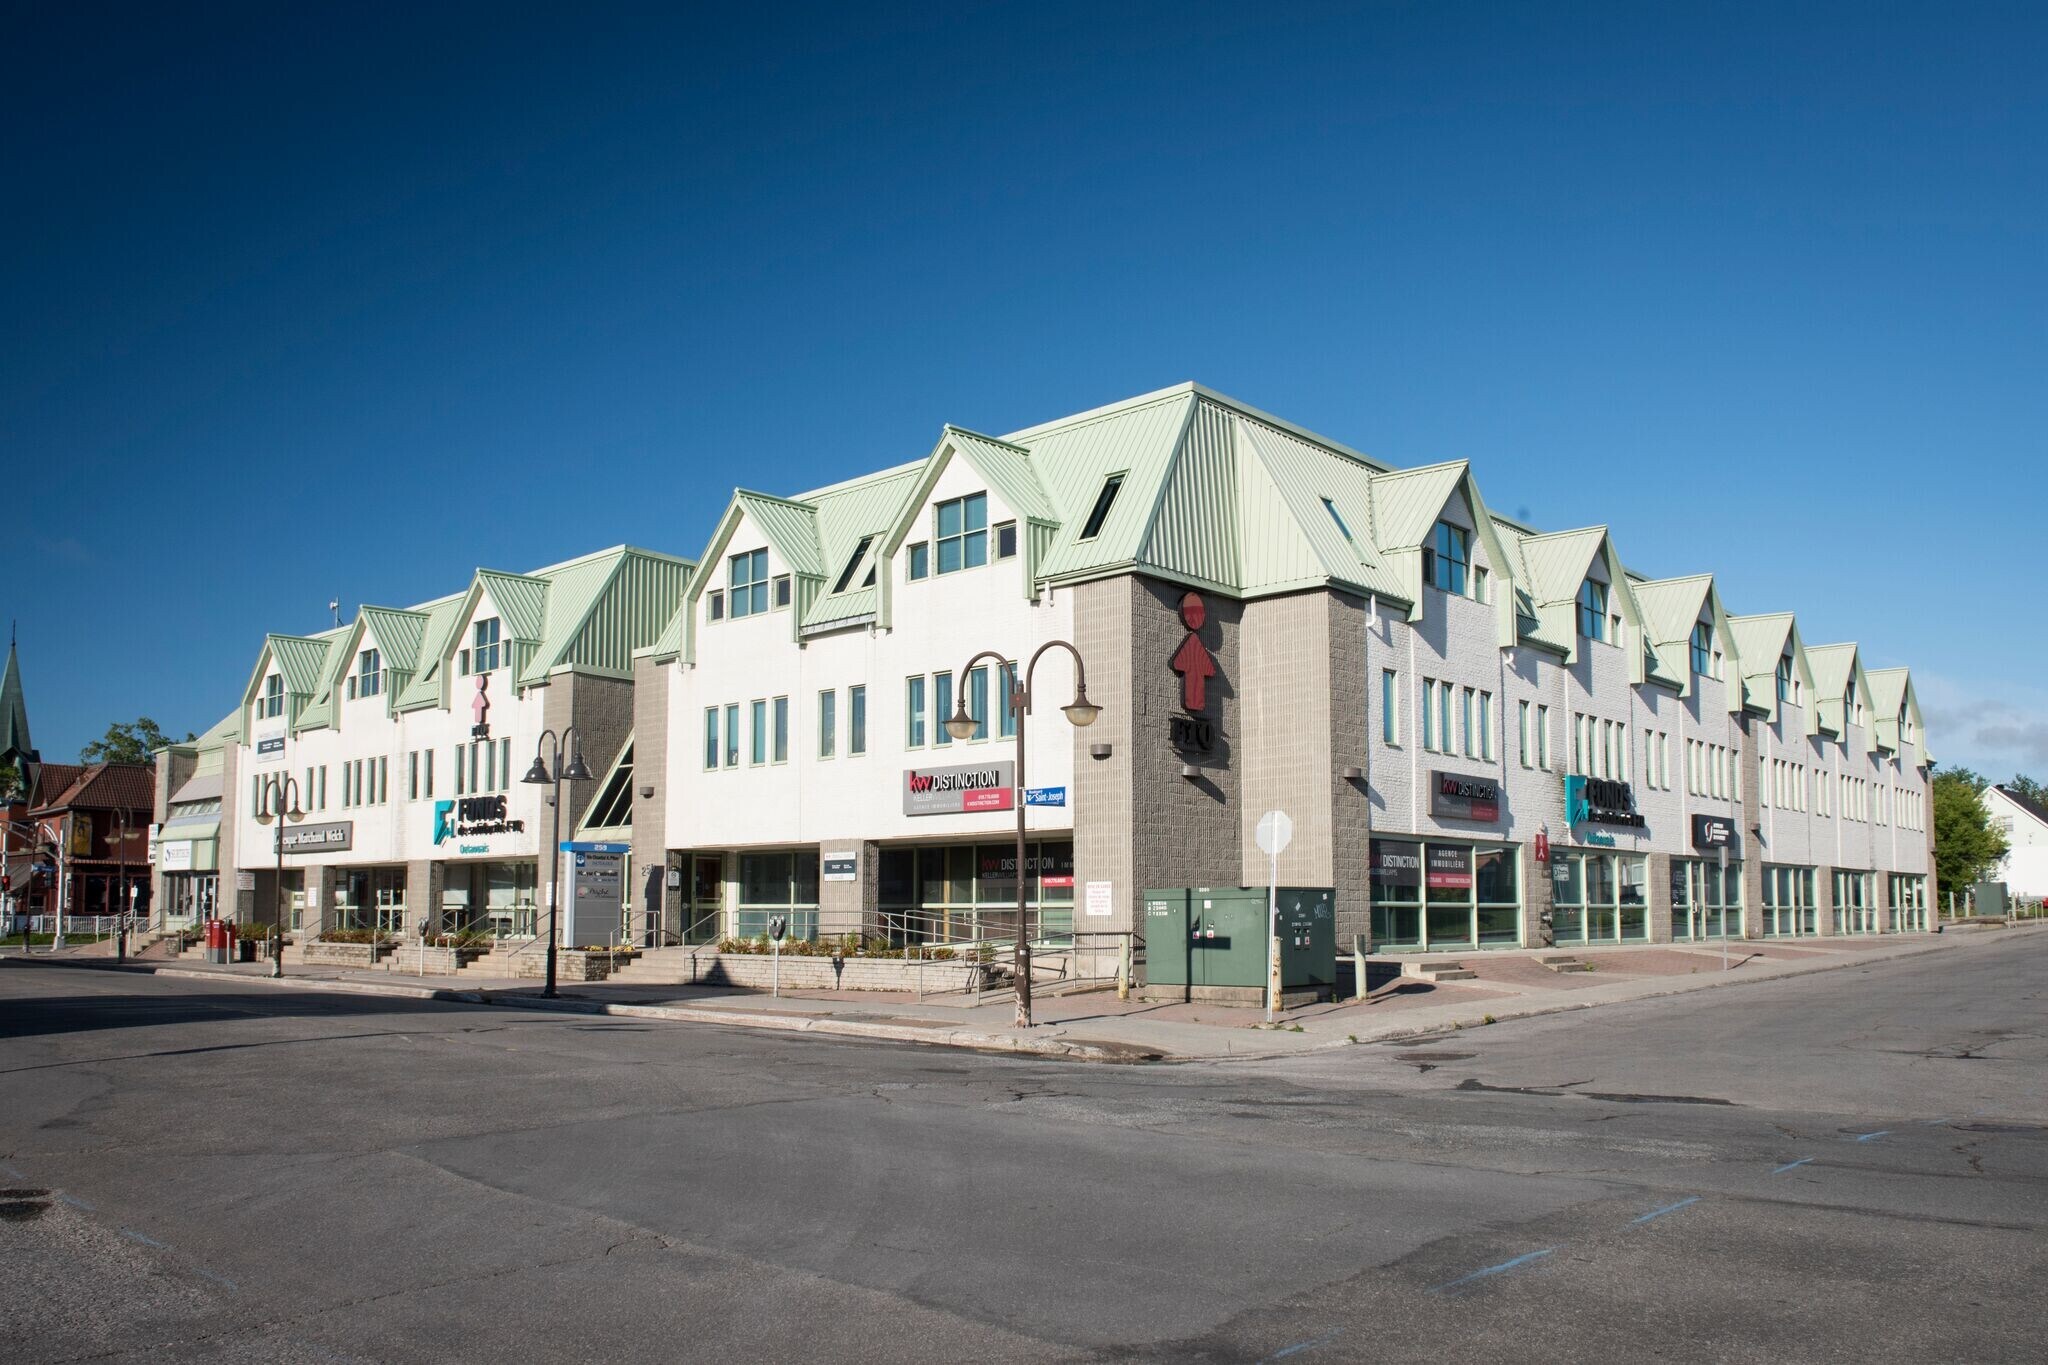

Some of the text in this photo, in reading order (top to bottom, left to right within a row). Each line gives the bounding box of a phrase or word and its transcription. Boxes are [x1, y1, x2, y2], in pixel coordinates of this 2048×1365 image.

[933, 770, 999, 791] DISTINCTION
[1458, 782, 1497, 799] DISTINCTION
[458, 795, 507, 823] FONDS
[1382, 855, 1420, 869] DISTINCTION
[1438, 850, 1458, 858] AGENCE
